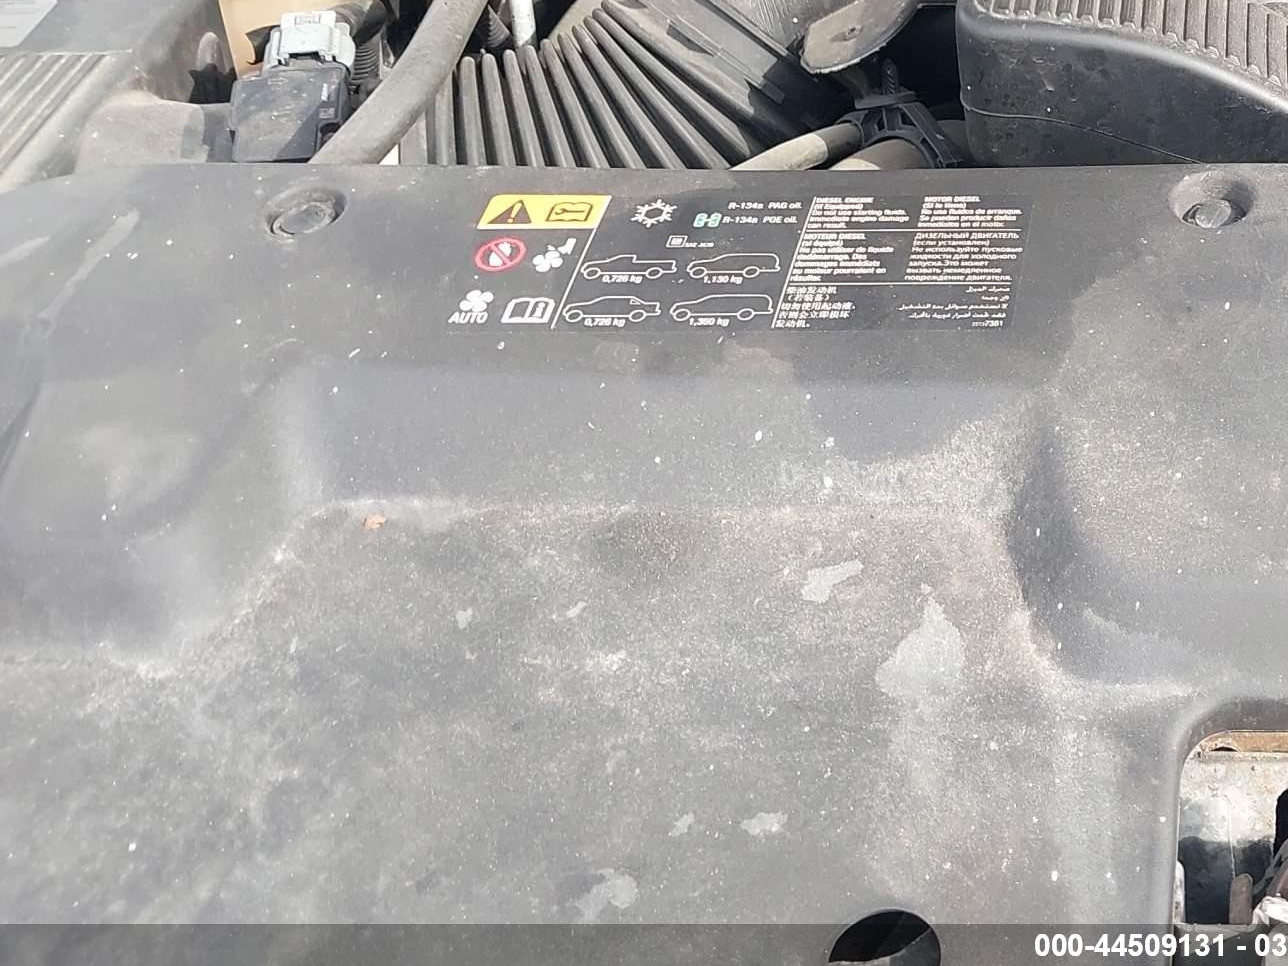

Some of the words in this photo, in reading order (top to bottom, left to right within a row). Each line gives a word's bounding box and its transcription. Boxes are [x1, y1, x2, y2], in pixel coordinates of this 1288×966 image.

[629, 275, 643, 283] kg
[729, 275, 743, 284] kg
[447, 311, 489, 324] AUTO
[611, 317, 626, 327] kg
[716, 317, 730, 327] kg
